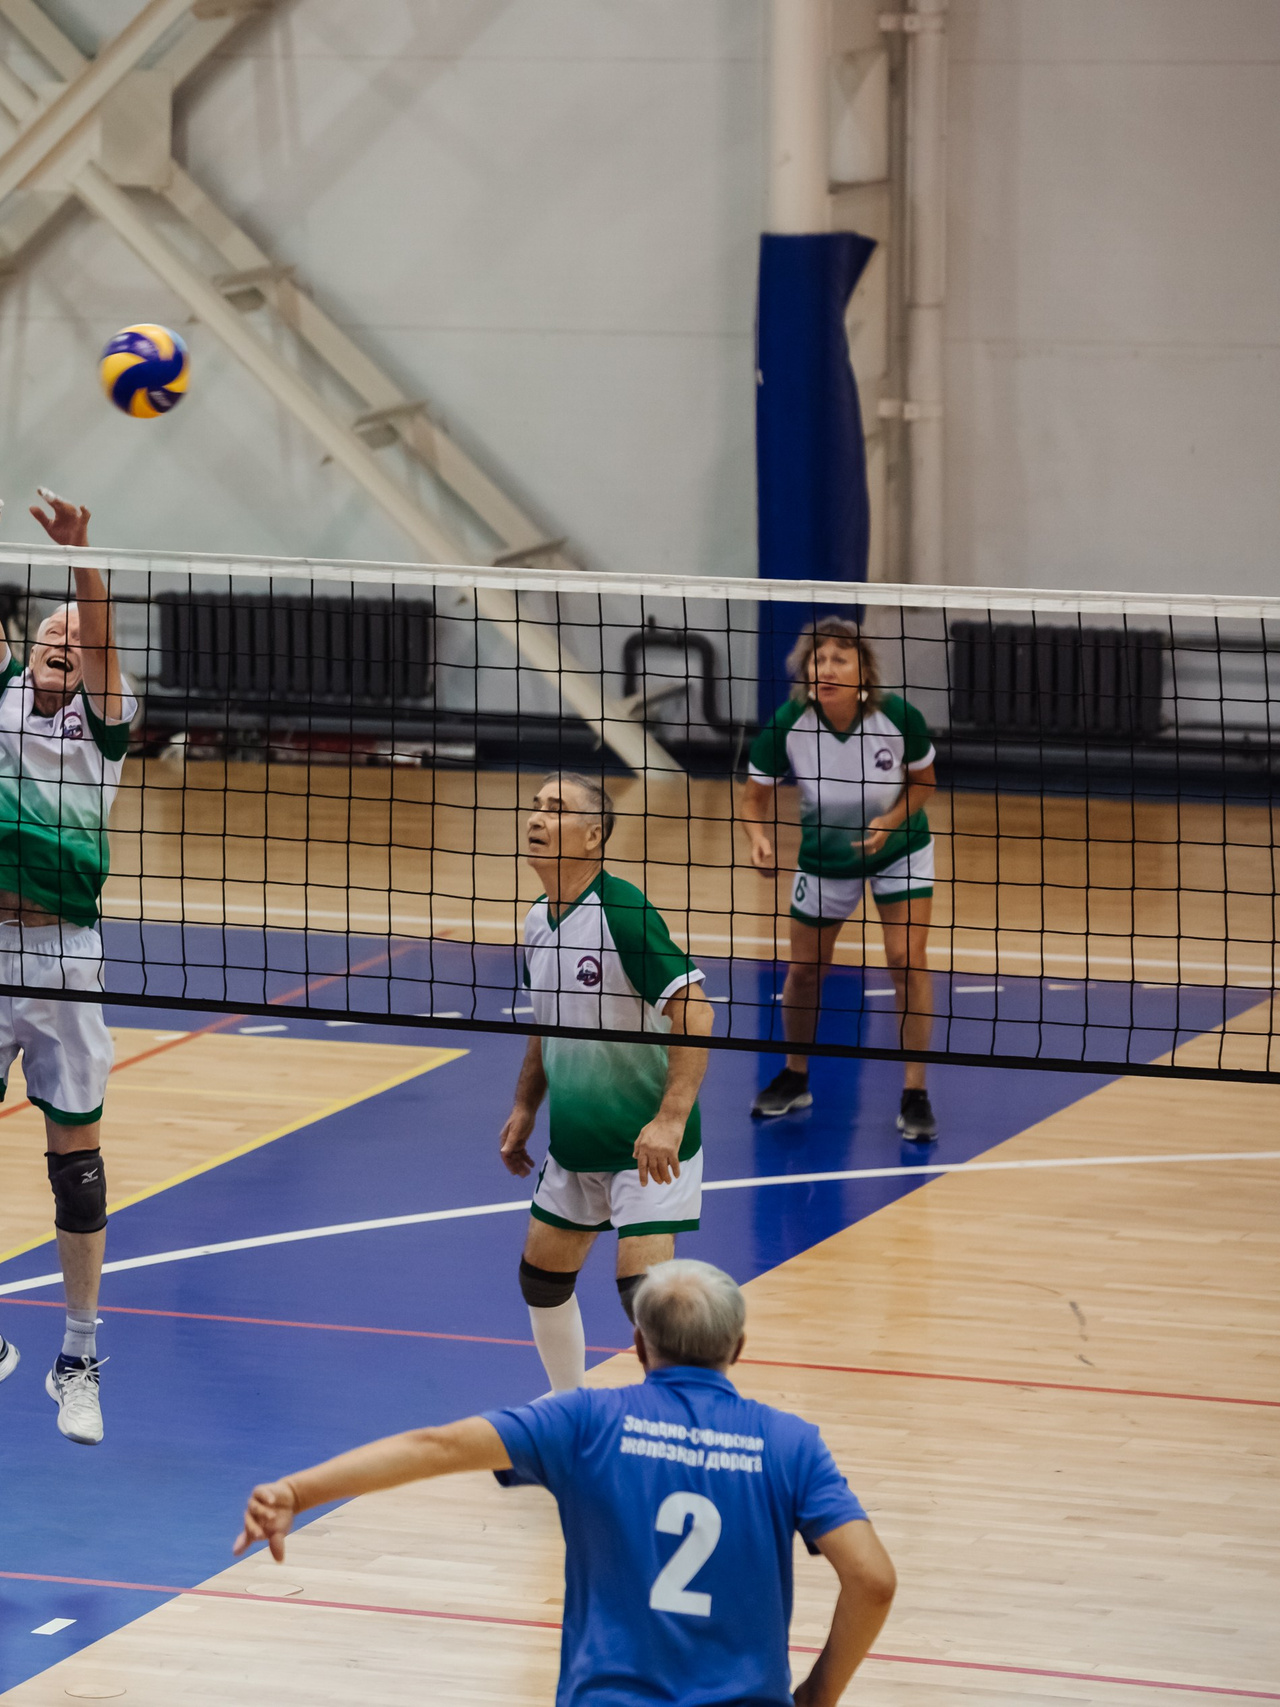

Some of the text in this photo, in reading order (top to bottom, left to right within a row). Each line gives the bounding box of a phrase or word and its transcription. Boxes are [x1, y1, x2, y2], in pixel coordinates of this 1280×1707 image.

[795, 876, 807, 902] 6
[705, 1451, 763, 1473] дорога
[649, 1491, 722, 1617] 2
